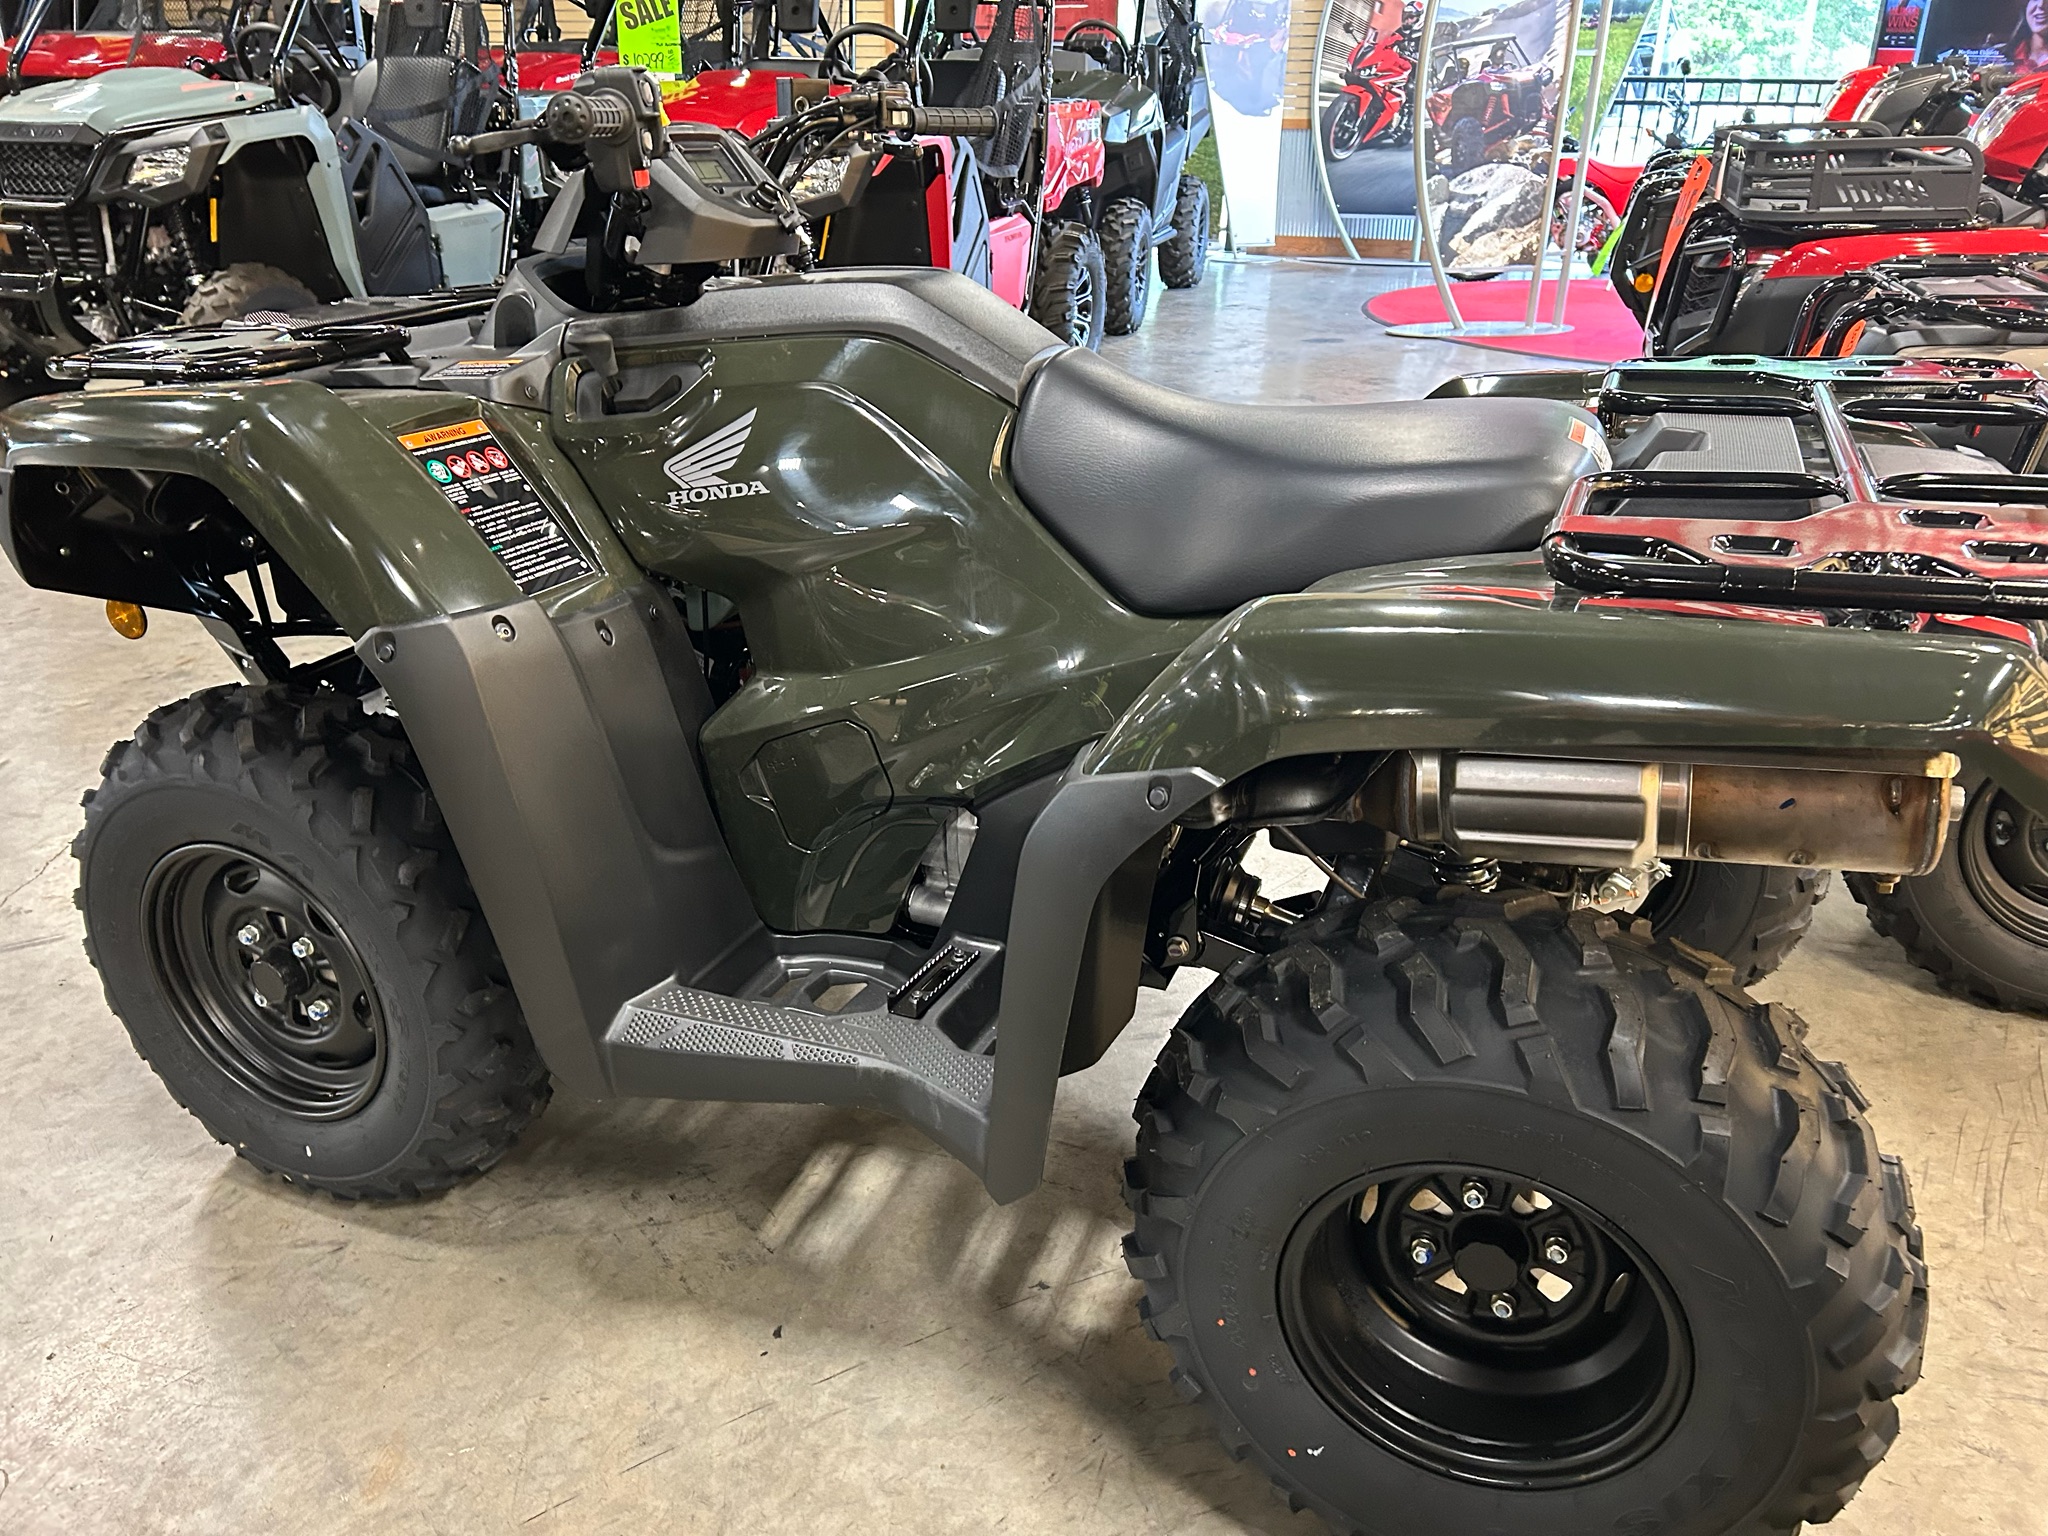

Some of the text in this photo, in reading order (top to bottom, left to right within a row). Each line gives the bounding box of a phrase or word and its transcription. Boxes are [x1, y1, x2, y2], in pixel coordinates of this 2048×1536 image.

[620, 0, 674, 30] SALE
[1887, 16, 1918, 28] WINS
[623, 54, 629, 65] $
[633, 52, 665, 69] 10299
[426, 427, 467, 441] WARNING
[667, 480, 770, 506] HONDA
